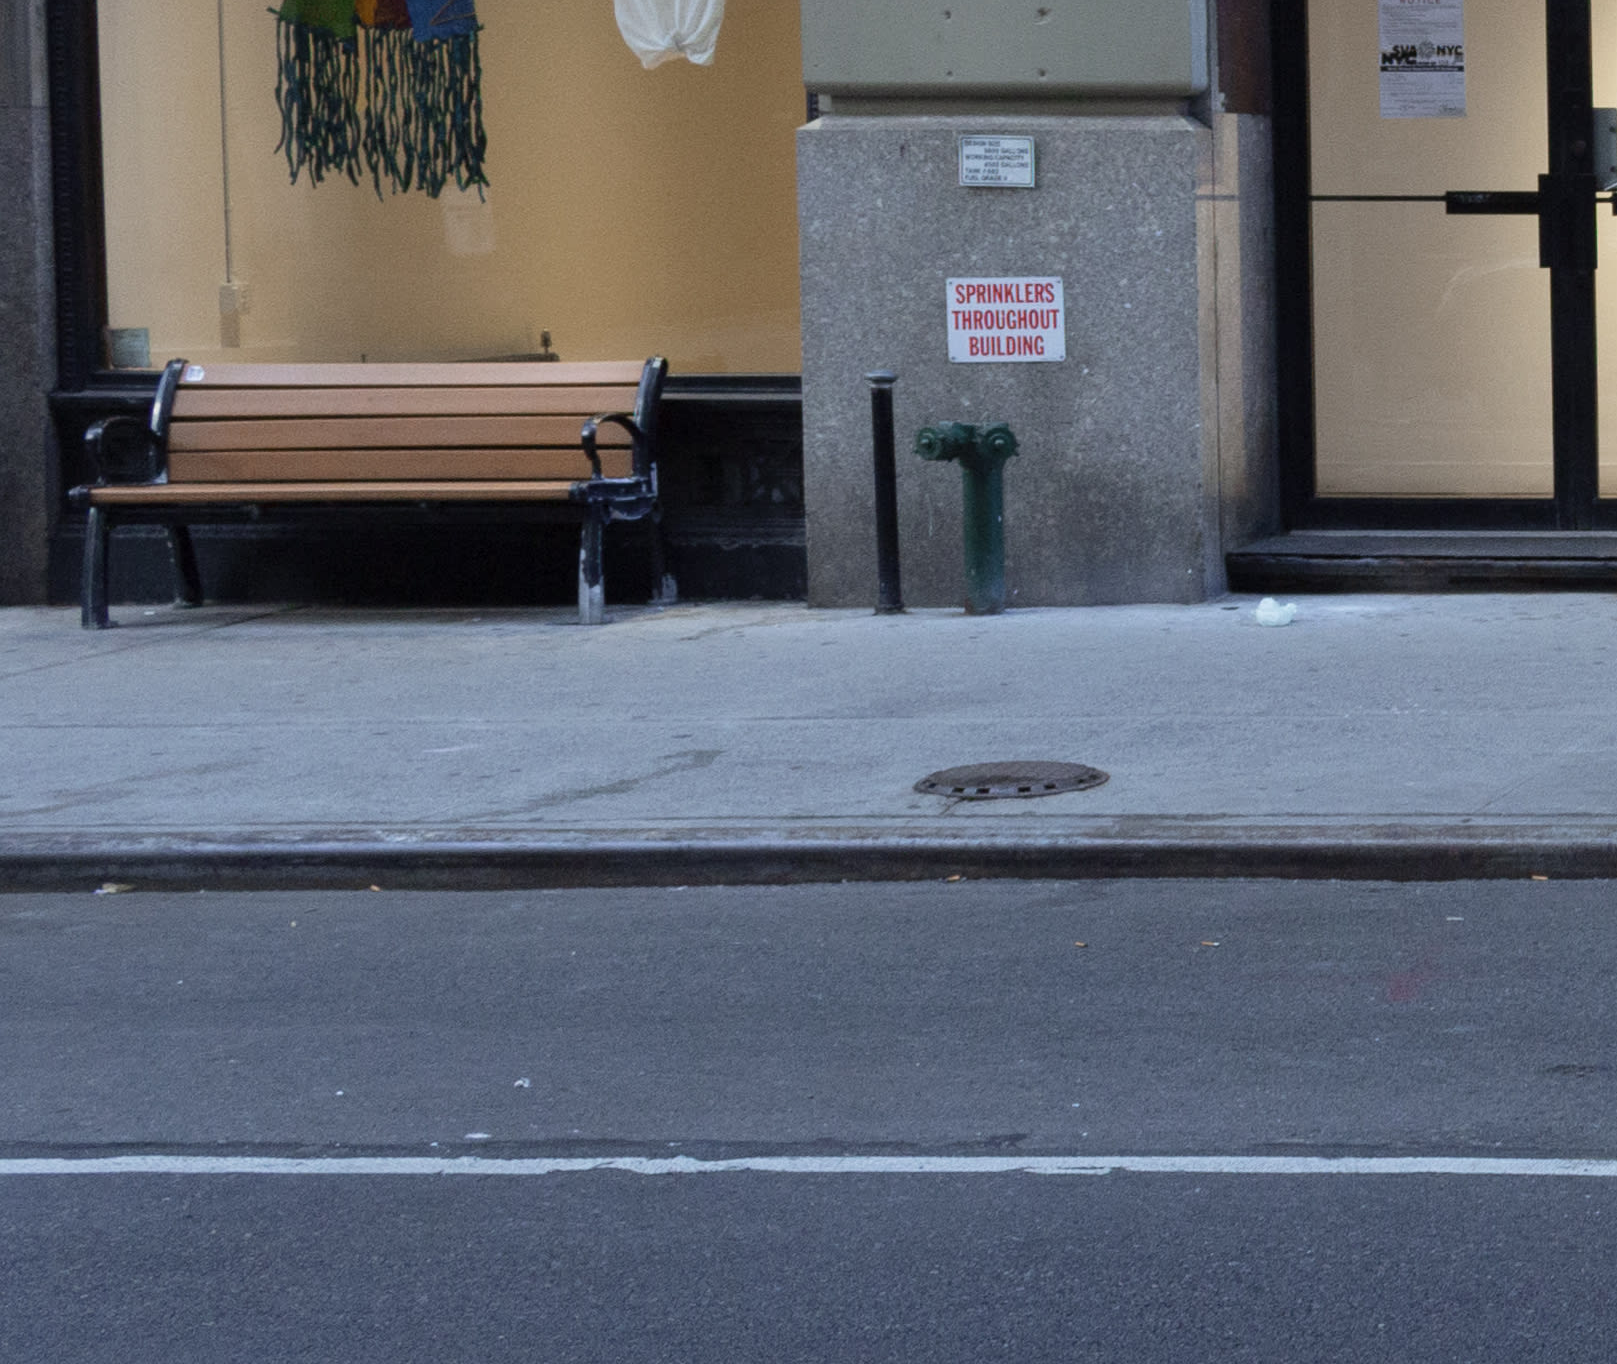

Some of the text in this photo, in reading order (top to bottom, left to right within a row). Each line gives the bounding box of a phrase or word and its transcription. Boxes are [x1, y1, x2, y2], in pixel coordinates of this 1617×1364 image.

[1381, 52, 1418, 65] NYC
[1436, 44, 1464, 56] NYC
[955, 283, 1055, 304] SPRINKLERS
[952, 309, 1060, 330] THROUGHOUT
[968, 335, 1045, 357] BUILDING
